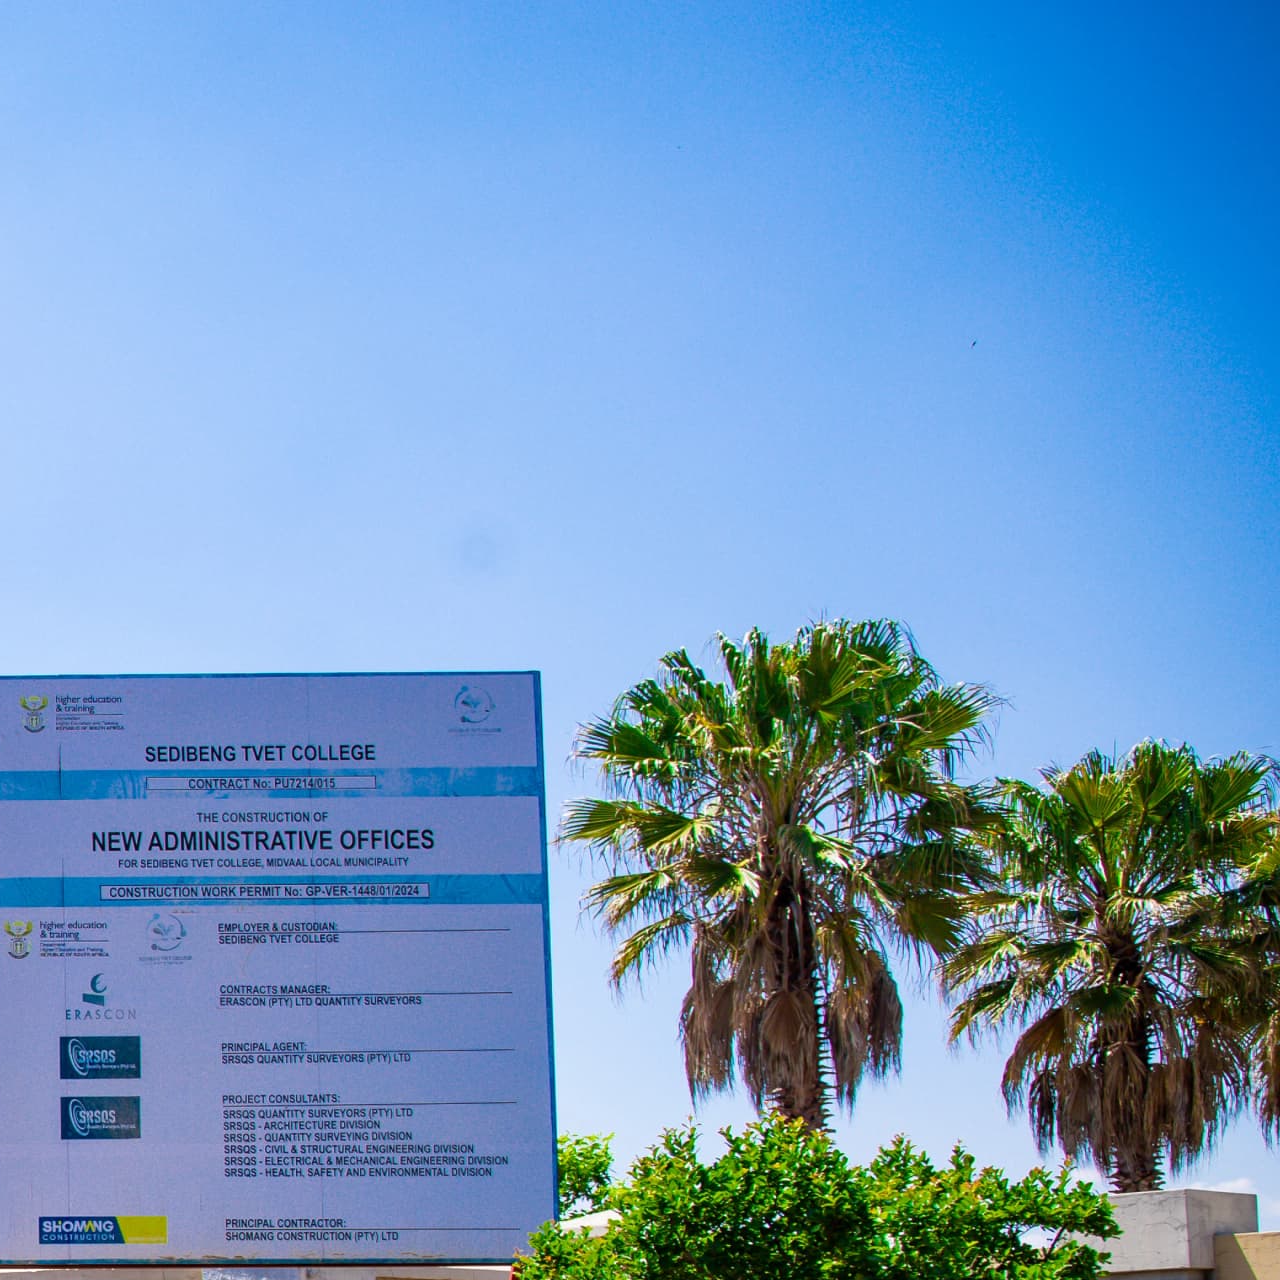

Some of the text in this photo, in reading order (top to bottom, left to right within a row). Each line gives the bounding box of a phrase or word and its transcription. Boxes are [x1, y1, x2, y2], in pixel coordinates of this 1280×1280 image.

[55, 695, 122, 706] higher education
[55, 704, 95, 715] & training
[145, 744, 376, 762] SEDIBENG TVET COLLEGE
[188, 777, 336, 790] CONTRACT No: PU7214/015
[196, 811, 328, 823] THE CONSTRUCTION OF
[92, 829, 434, 851] NEW ADMINISTRATIVE OFFICES
[118, 856, 409, 869] FOR SEDIBENG TVET COLLEGE, MIDVAAL LOCAL MUNICIPALITY
[109, 885, 419, 898] CONSTRUCTION WORK PERMIT No: GP-VER-1448/01/2024
[39, 920, 108, 931] higher education
[218, 922, 338, 933] EMPLOYER & CUSTODIAN:
[40, 930, 79, 941] & training
[218, 933, 340, 944] SEDIBENG TVET COLLEGE
[219, 984, 331, 994] CONTRACTS MANAGER:
[219, 995, 422, 1009] ERASCON (PTY) LTD QUANTITY SURVEYORS
[65, 1008, 137, 1020] ERASCON
[221, 1042, 307, 1052] PRINCIPAL AGENT:
[79, 1049, 116, 1063] SRSQS
[222, 1053, 411, 1064] SRSQS QUANTITY SURVEYORS (PTY) LTD
[222, 1094, 341, 1104] PROJECT CONSULTANTS:
[80, 1110, 116, 1123] SRSQS
[223, 1108, 414, 1119] SRSQS QUANTITY SURVEYORS (PTY) LTD
[223, 1121, 256, 1131] SRSQS
[264, 1120, 337, 1130] ARCHITECTURE
[339, 1119, 381, 1130] DIVISION
[223, 1133, 256, 1143] SRSQS
[264, 1132, 312, 1143] QUANTITY
[314, 1132, 369, 1142] SURVEYING
[372, 1131, 413, 1141] DIVISION
[224, 1145, 257, 1154] SRSQS
[265, 1145, 288, 1154] CIVIL
[291, 1145, 297, 1154] &
[300, 1144, 364, 1154] STRUCTURAL
[366, 1144, 431, 1154] ENGINEERING
[433, 1144, 474, 1153] DIVISION
[224, 1156, 257, 1166] SRSQS
[265, 1156, 324, 1166] ELECTRICAL
[326, 1156, 333, 1166] &
[335, 1156, 398, 1165] MECHANICAL
[400, 1156, 465, 1165] ENGINEERING
[467, 1156, 508, 1165] DIVISION
[224, 1168, 257, 1177] SRSQS
[265, 1168, 304, 1178] HEALTH,
[307, 1168, 344, 1177] SAFETY
[346, 1168, 366, 1177] AND
[369, 1168, 449, 1177] ENVIRONMENTAL
[451, 1168, 492, 1177] DIVISION
[42, 1220, 114, 1232] SHOMANG
[225, 1218, 346, 1228] PRINCIPAL CONTRACTOR:
[42, 1233, 115, 1241] CONSTRUCTION
[225, 1231, 399, 1243] SHOMANG CONSTRUCTION (PTY) LTD
